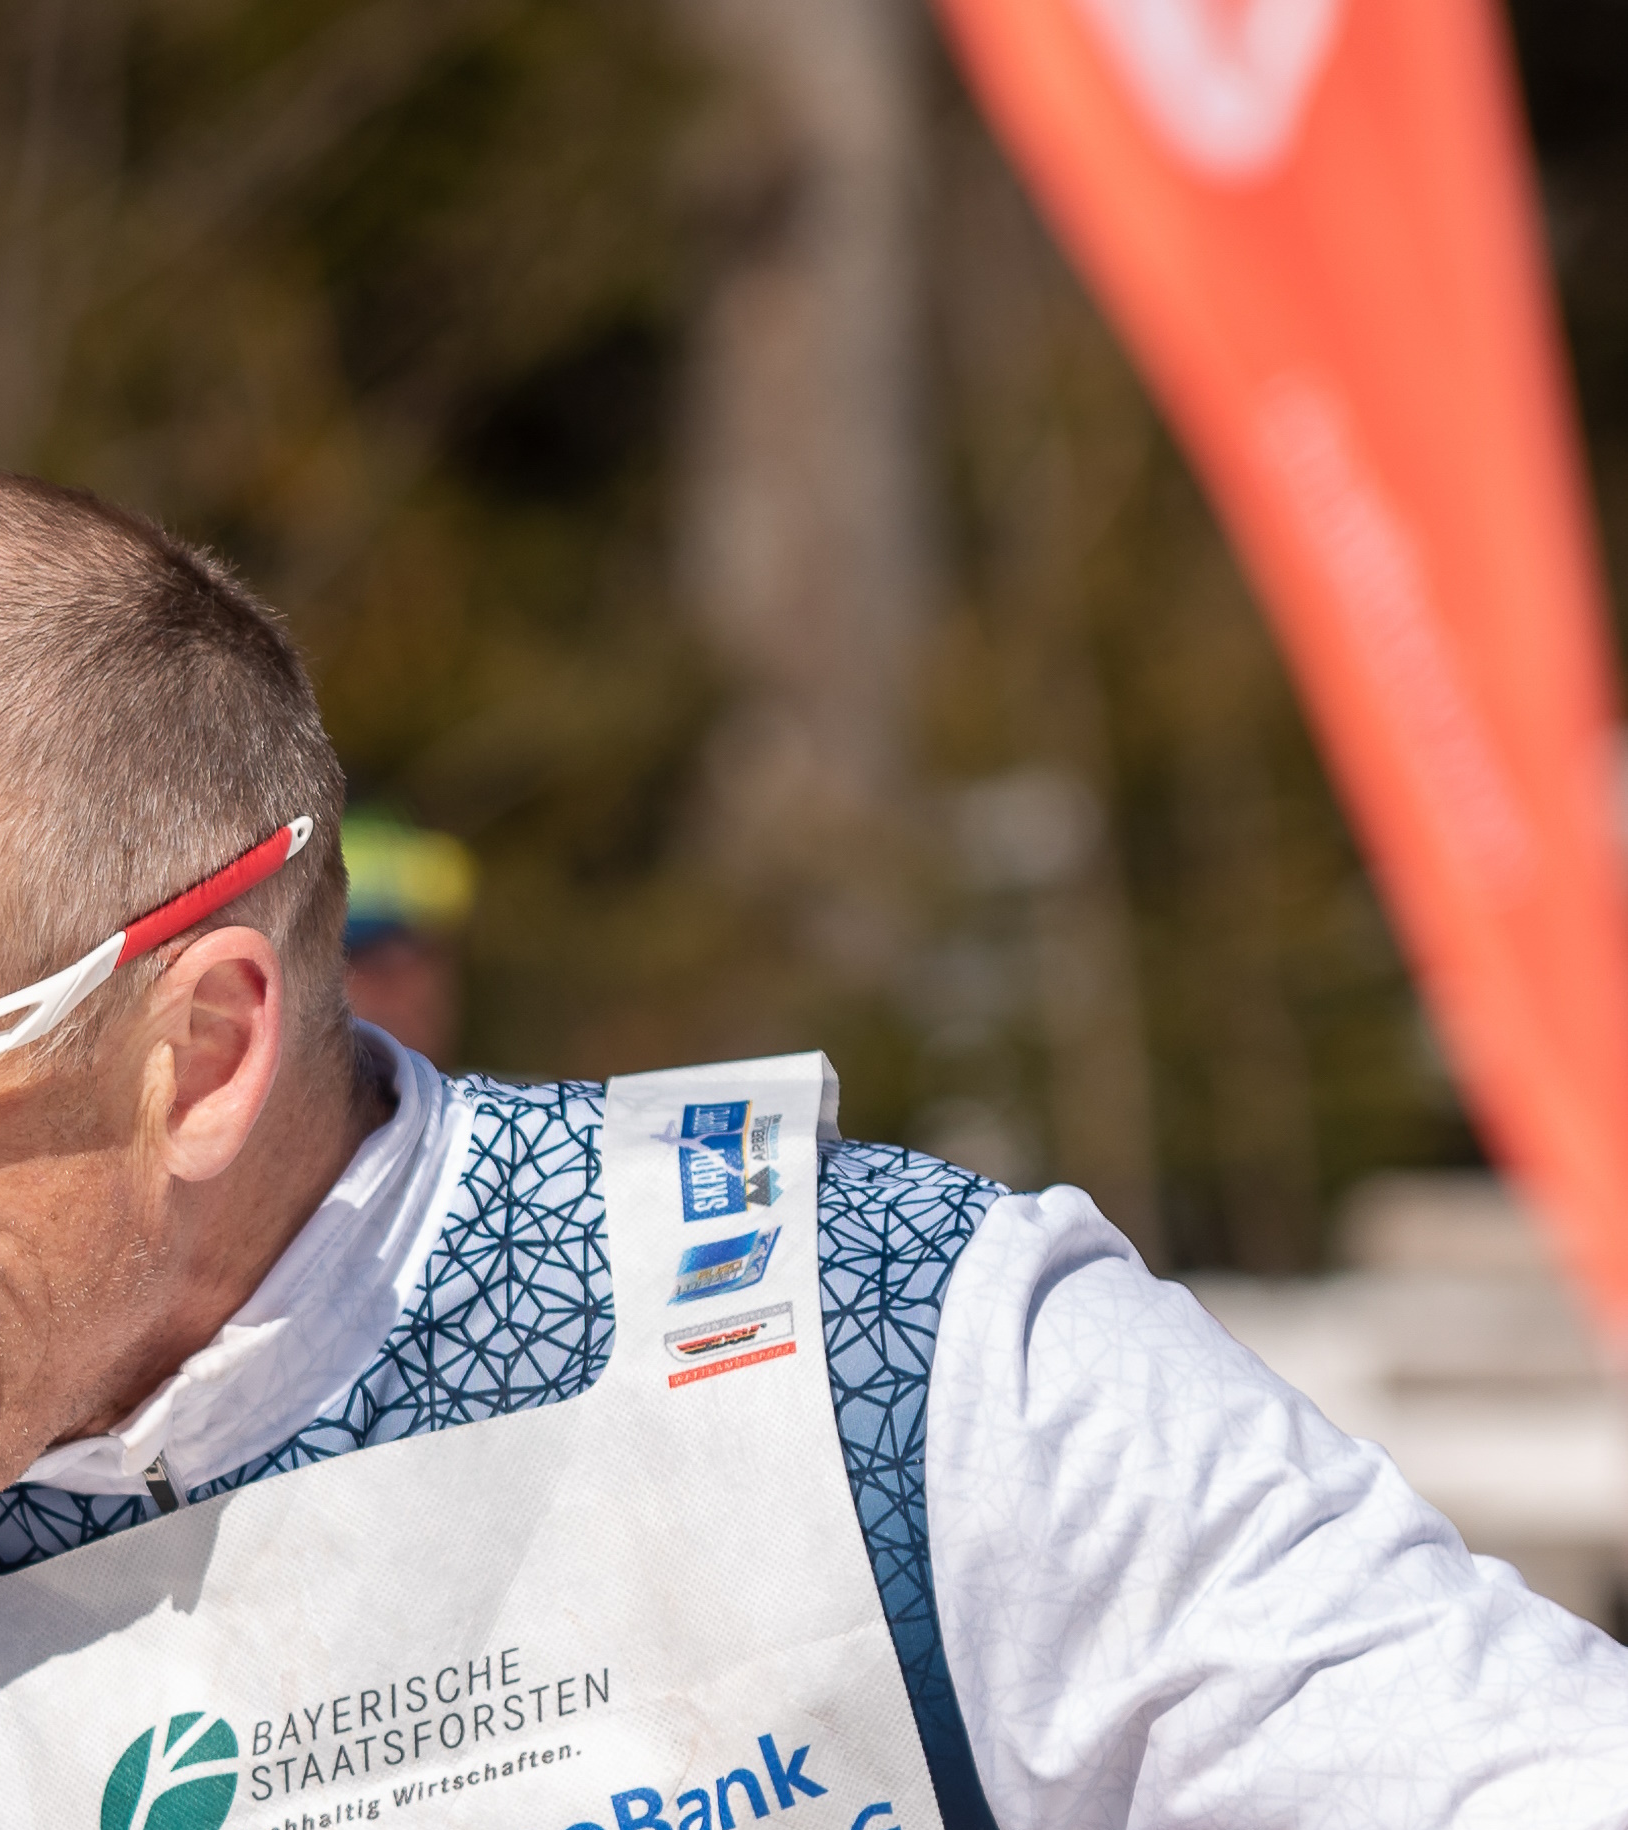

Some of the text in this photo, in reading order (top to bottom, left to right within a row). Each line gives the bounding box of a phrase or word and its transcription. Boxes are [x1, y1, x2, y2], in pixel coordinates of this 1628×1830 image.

[249, 1667, 613, 1802] STAATSFORSTEN
[251, 1647, 523, 1759] BAYERISCHE
[392, 1744, 584, 1809] Wirtschaften.
